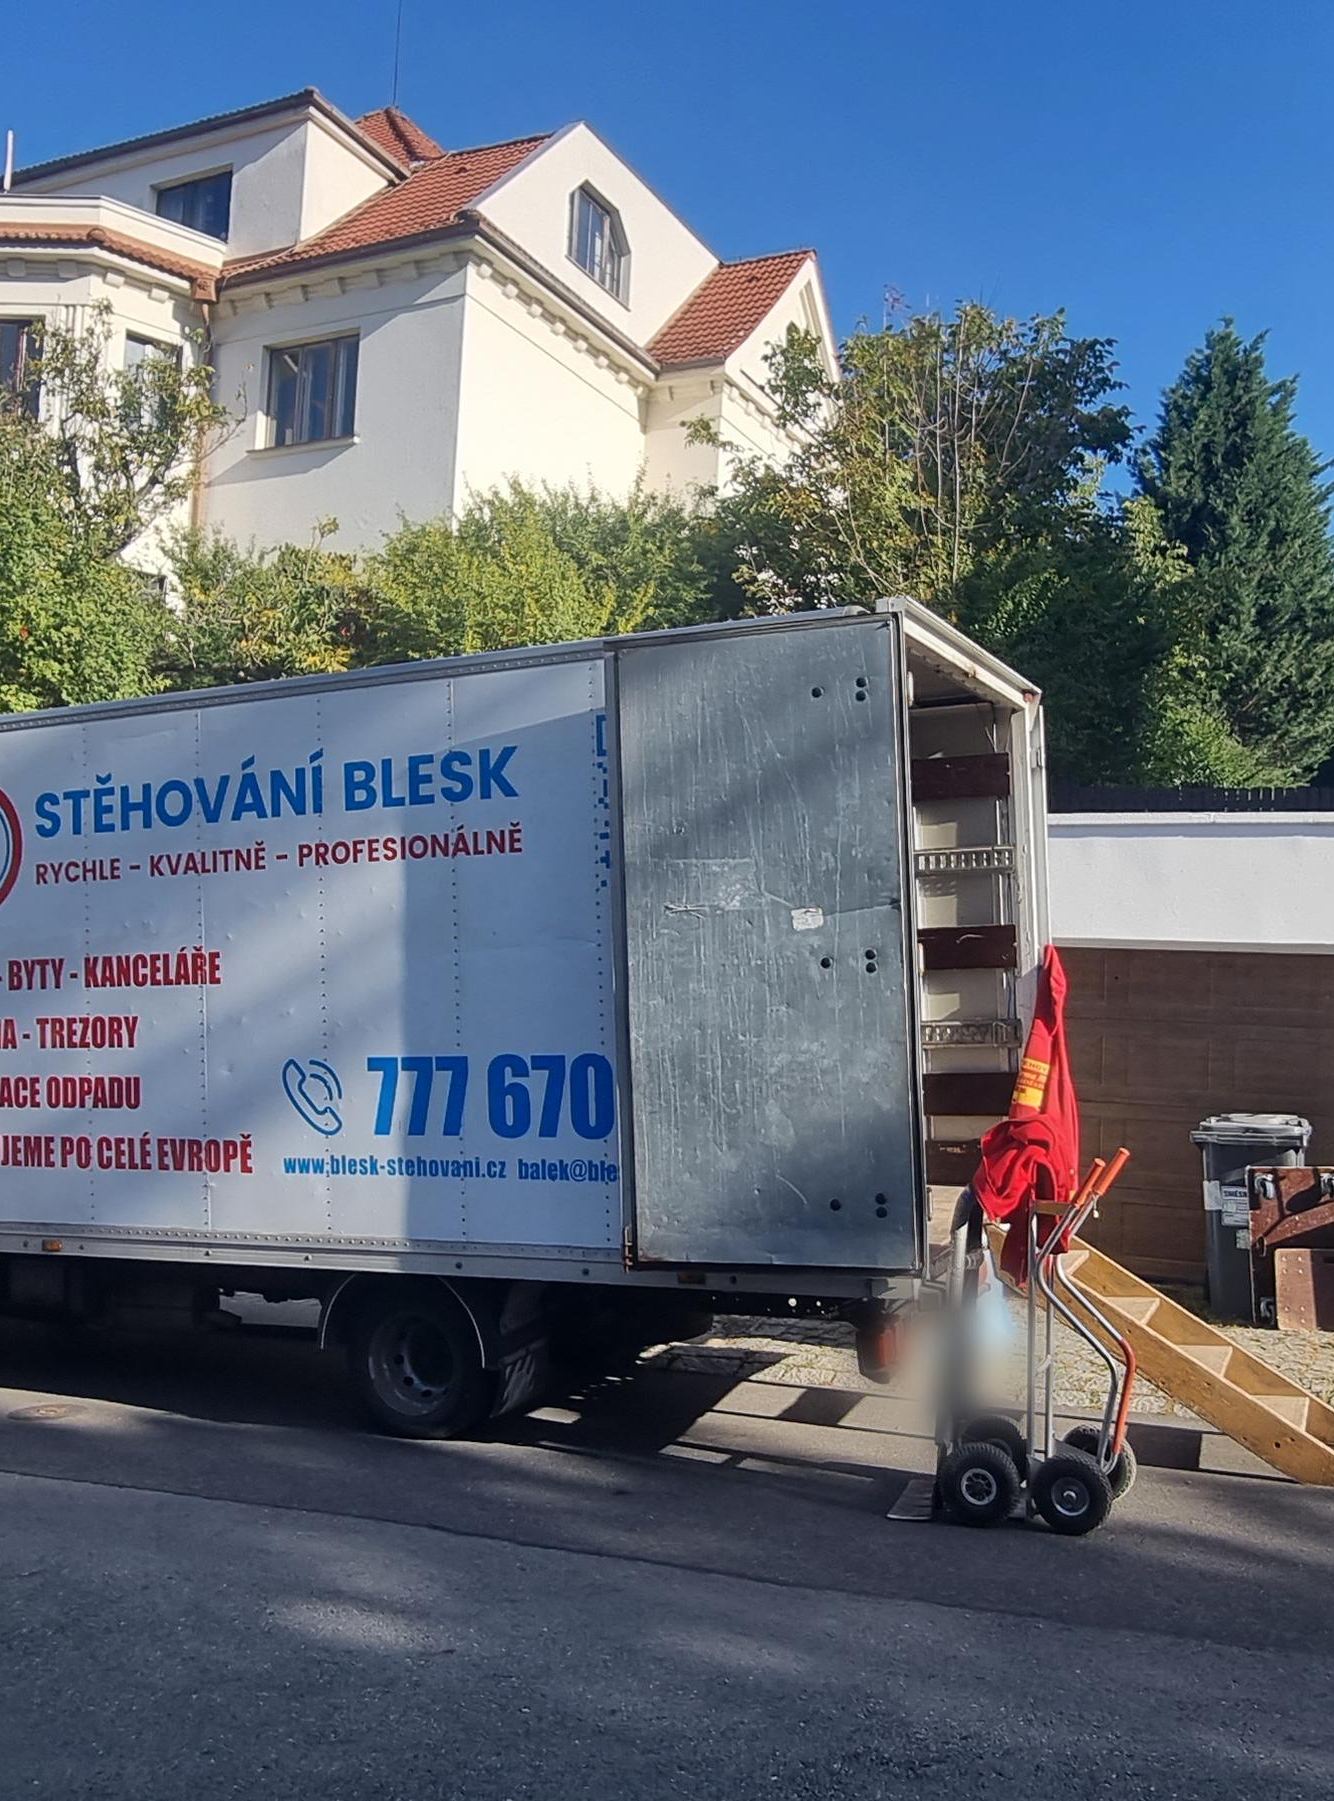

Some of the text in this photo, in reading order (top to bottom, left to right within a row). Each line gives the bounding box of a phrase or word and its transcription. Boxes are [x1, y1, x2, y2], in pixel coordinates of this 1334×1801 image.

[35, 746, 519, 838] STĚHOVÁNÍ BLESK
[36, 857, 121, 885] RYCHLE
[149, 840, 266, 878] KVALITNĚ
[298, 822, 523, 867] PROFESIONÁLNĚ
[8, 958, 64, 991] BYTY
[84, 946, 222, 988] KANCELÁŘE
[37, 1015, 138, 1049] TREZORY
[47, 1075, 141, 1110] ODPADU
[367, 1053, 614, 1140] 777 670
[60, 1135, 91, 1169] PO
[96, 1130, 153, 1171] CELÉ
[158, 1133, 253, 1174] EVROPĚ
[283, 1154, 507, 1180] www.blesk-stehovani.cz
